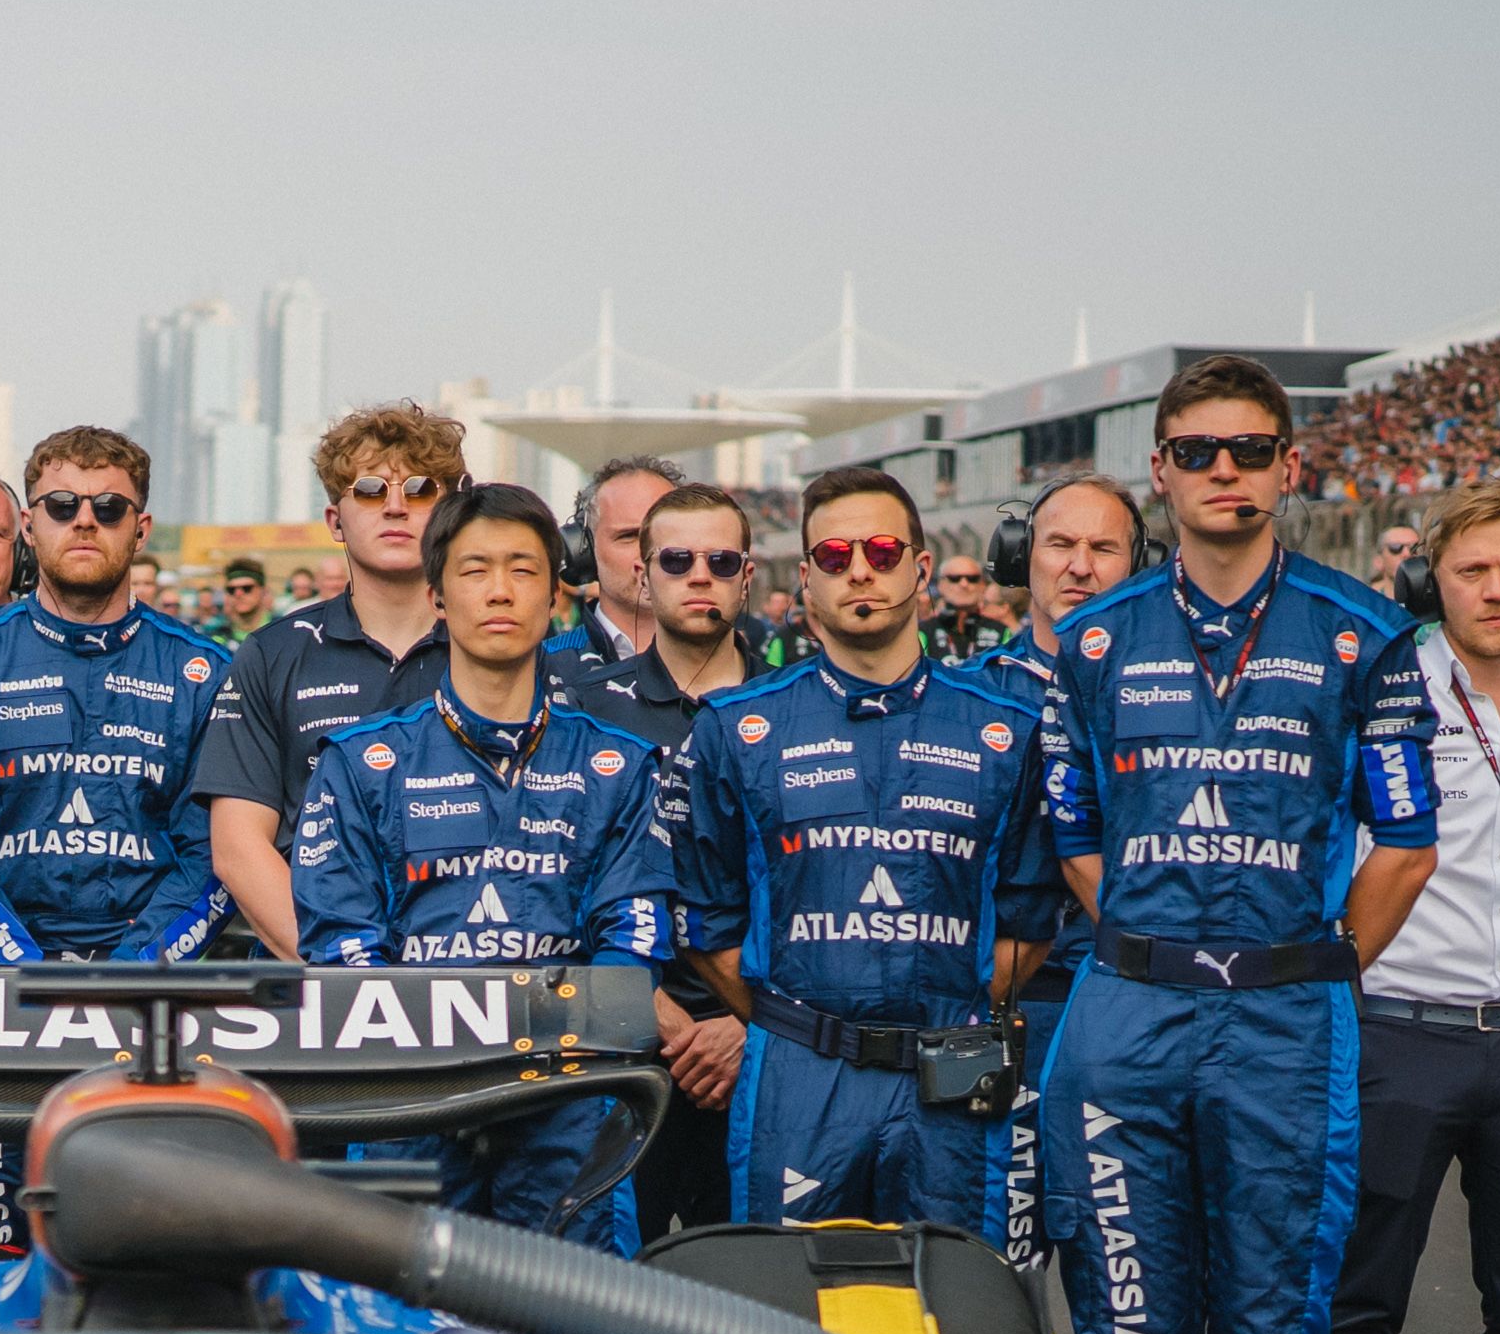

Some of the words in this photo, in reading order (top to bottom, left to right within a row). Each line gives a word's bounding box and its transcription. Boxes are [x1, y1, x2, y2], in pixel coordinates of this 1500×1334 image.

[1122, 658, 1195, 676] KOMATSU
[0, 675, 63, 692] KOMATSU
[297, 683, 359, 699] KOMATSU
[1120, 686, 1192, 706] Stephens
[0, 702, 63, 721] Stephens
[307, 716, 360, 731] MYPROTEIN
[1236, 716, 1310, 736] DURACELL
[103, 724, 166, 747] DURACELL
[782, 738, 853, 759] KOMATSU
[909, 740, 981, 765] ATLASSIAN
[23, 753, 164, 784] MYPROTEIN
[1142, 746, 1312, 777] MYPROTEIN
[405, 773, 475, 789] KOMATSU
[784, 768, 856, 789] Stephens
[409, 799, 480, 820] Stephens
[901, 795, 976, 819] DURACELL
[808, 826, 976, 860] MYPROTEIN
[1122, 834, 1299, 871] ATLASSIAN
[789, 912, 970, 946] ATLASSIAN
